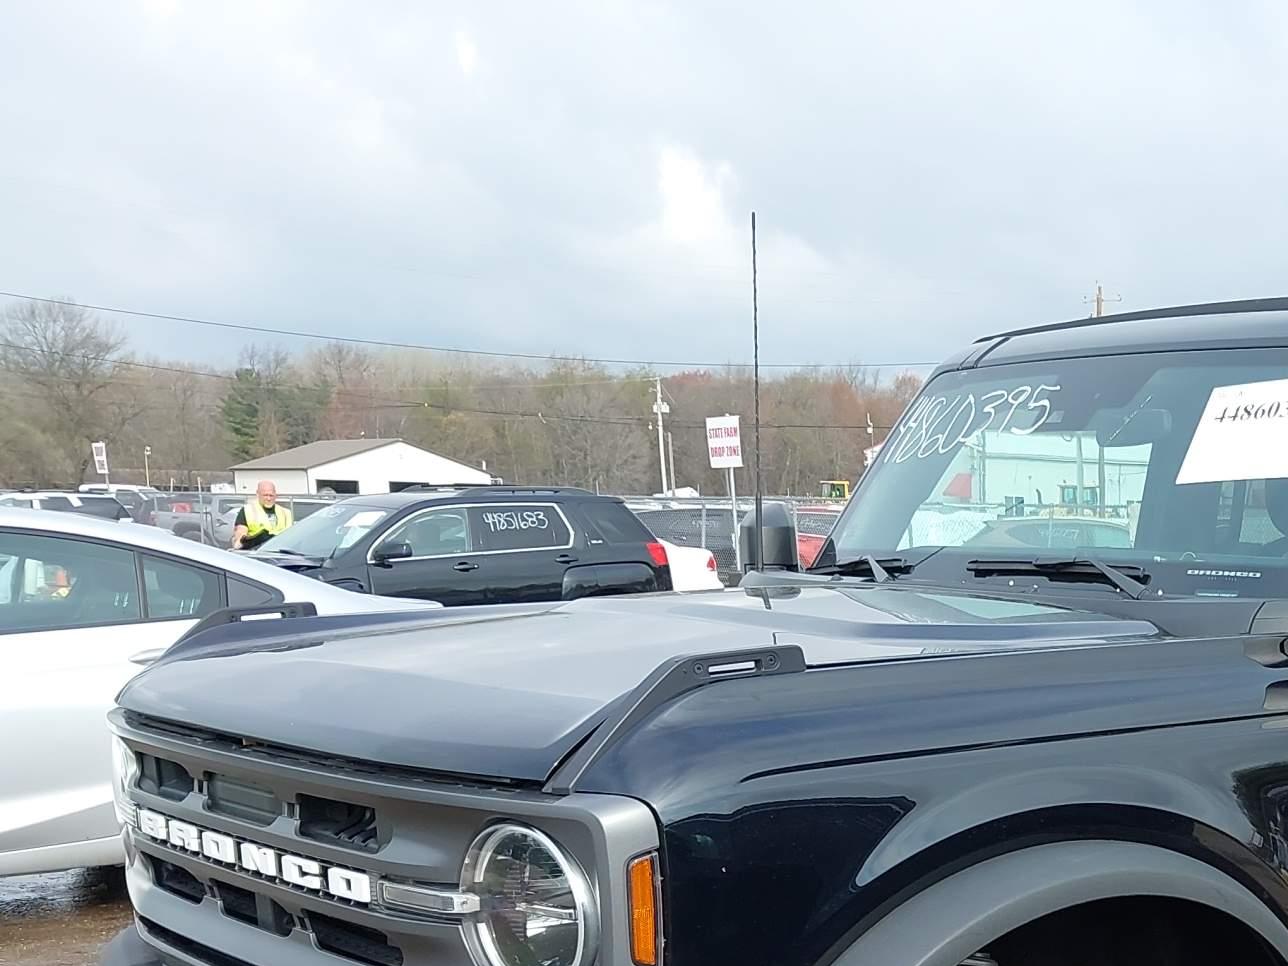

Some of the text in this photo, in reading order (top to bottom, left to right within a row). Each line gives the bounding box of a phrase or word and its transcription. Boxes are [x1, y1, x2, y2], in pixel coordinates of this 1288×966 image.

[709, 427, 737, 438] STATE FARM
[884, 384, 1062, 464] 44860395
[711, 446, 740, 457] DROP ZONE
[482, 510, 549, 532] 44851683
[139, 809, 371, 903] BRONCO
